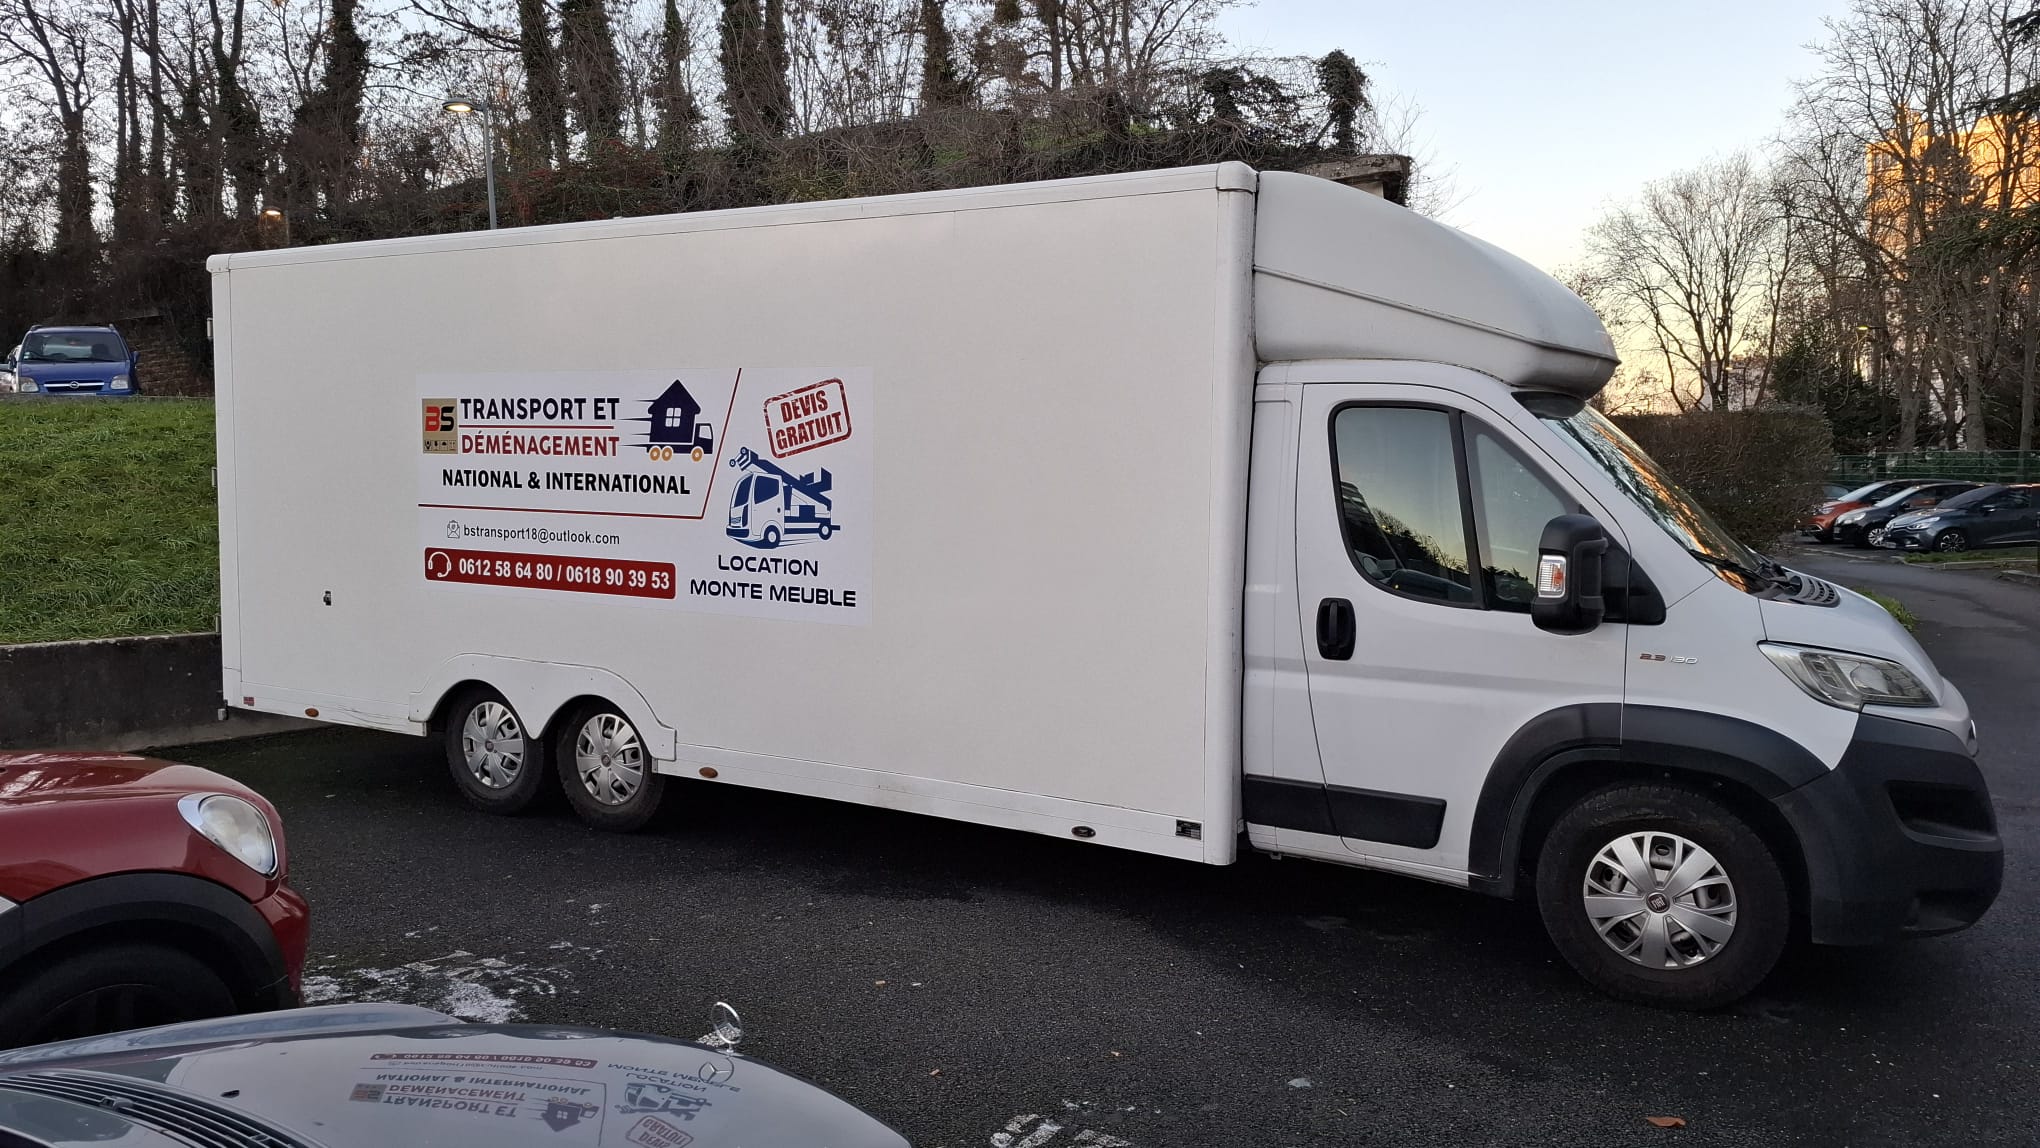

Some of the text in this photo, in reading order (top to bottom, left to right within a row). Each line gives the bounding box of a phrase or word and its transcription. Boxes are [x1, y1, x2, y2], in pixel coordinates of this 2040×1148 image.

[424, 406, 455, 432] BS
[460, 398, 620, 421] TRANSPORT ET
[779, 390, 829, 424] DEVIS
[461, 429, 620, 457] DÉMÉNAGEMENT
[775, 412, 844, 451] GRATUIT
[442, 469, 690, 495] NATIONAL & INTERNATIONAL
[463, 524, 620, 546] bstransport18@outlook.com
[459, 558, 670, 590] 0612 58 64 80 / 0618 90 39 53
[718, 555, 819, 577] LOCATION
[690, 579, 857, 608] MONTE MEUBLE
